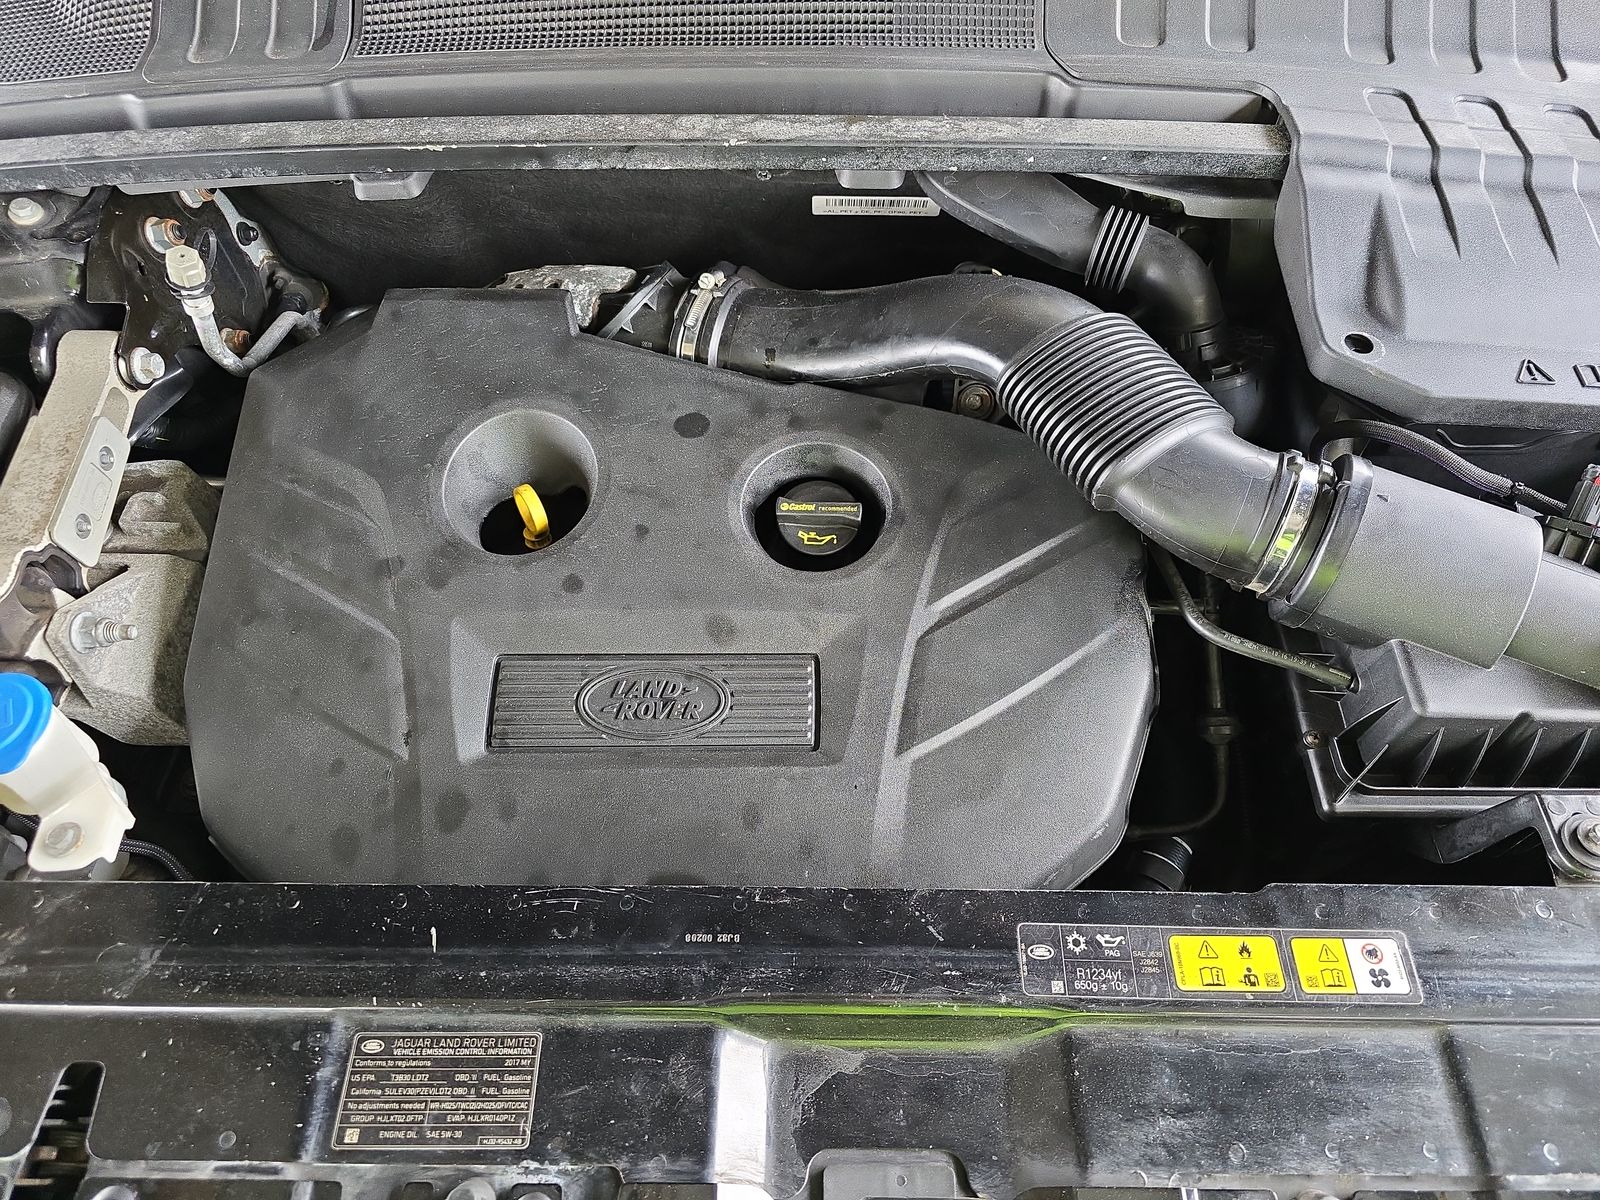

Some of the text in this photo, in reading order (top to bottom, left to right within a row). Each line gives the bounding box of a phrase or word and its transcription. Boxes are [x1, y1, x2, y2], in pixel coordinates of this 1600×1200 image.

[788, 502, 816, 511] Castrol
[609, 679, 683, 699] LAND
[614, 700, 704, 720] ROVER
[1104, 949, 1121, 957] PAG
[1132, 950, 1147, 958] SAE
[1076, 967, 1122, 982] R1234yf
[1074, 980, 1098, 992] 650g
[1111, 981, 1128, 993] 10g
[391, 1037, 431, 1048] JAGUAR
[432, 1037, 461, 1048] LAND
[462, 1037, 495, 1048] ROVER
[497, 1037, 536, 1048] LIMITED
[355, 1059, 386, 1067] Conforms
[396, 1059, 431, 1068] regulations
[351, 1073, 360, 1081] US
[411, 1073, 429, 1081] LDT2
[503, 1073, 532, 1081] Gasoline
[502, 1087, 530, 1095] Gasoline
[347, 1101, 425, 1111] No adjustments needed
[379, 1130, 406, 1138] ENGINE
[426, 1130, 440, 1138] SAE
[440, 1130, 463, 1138] 5W-30
